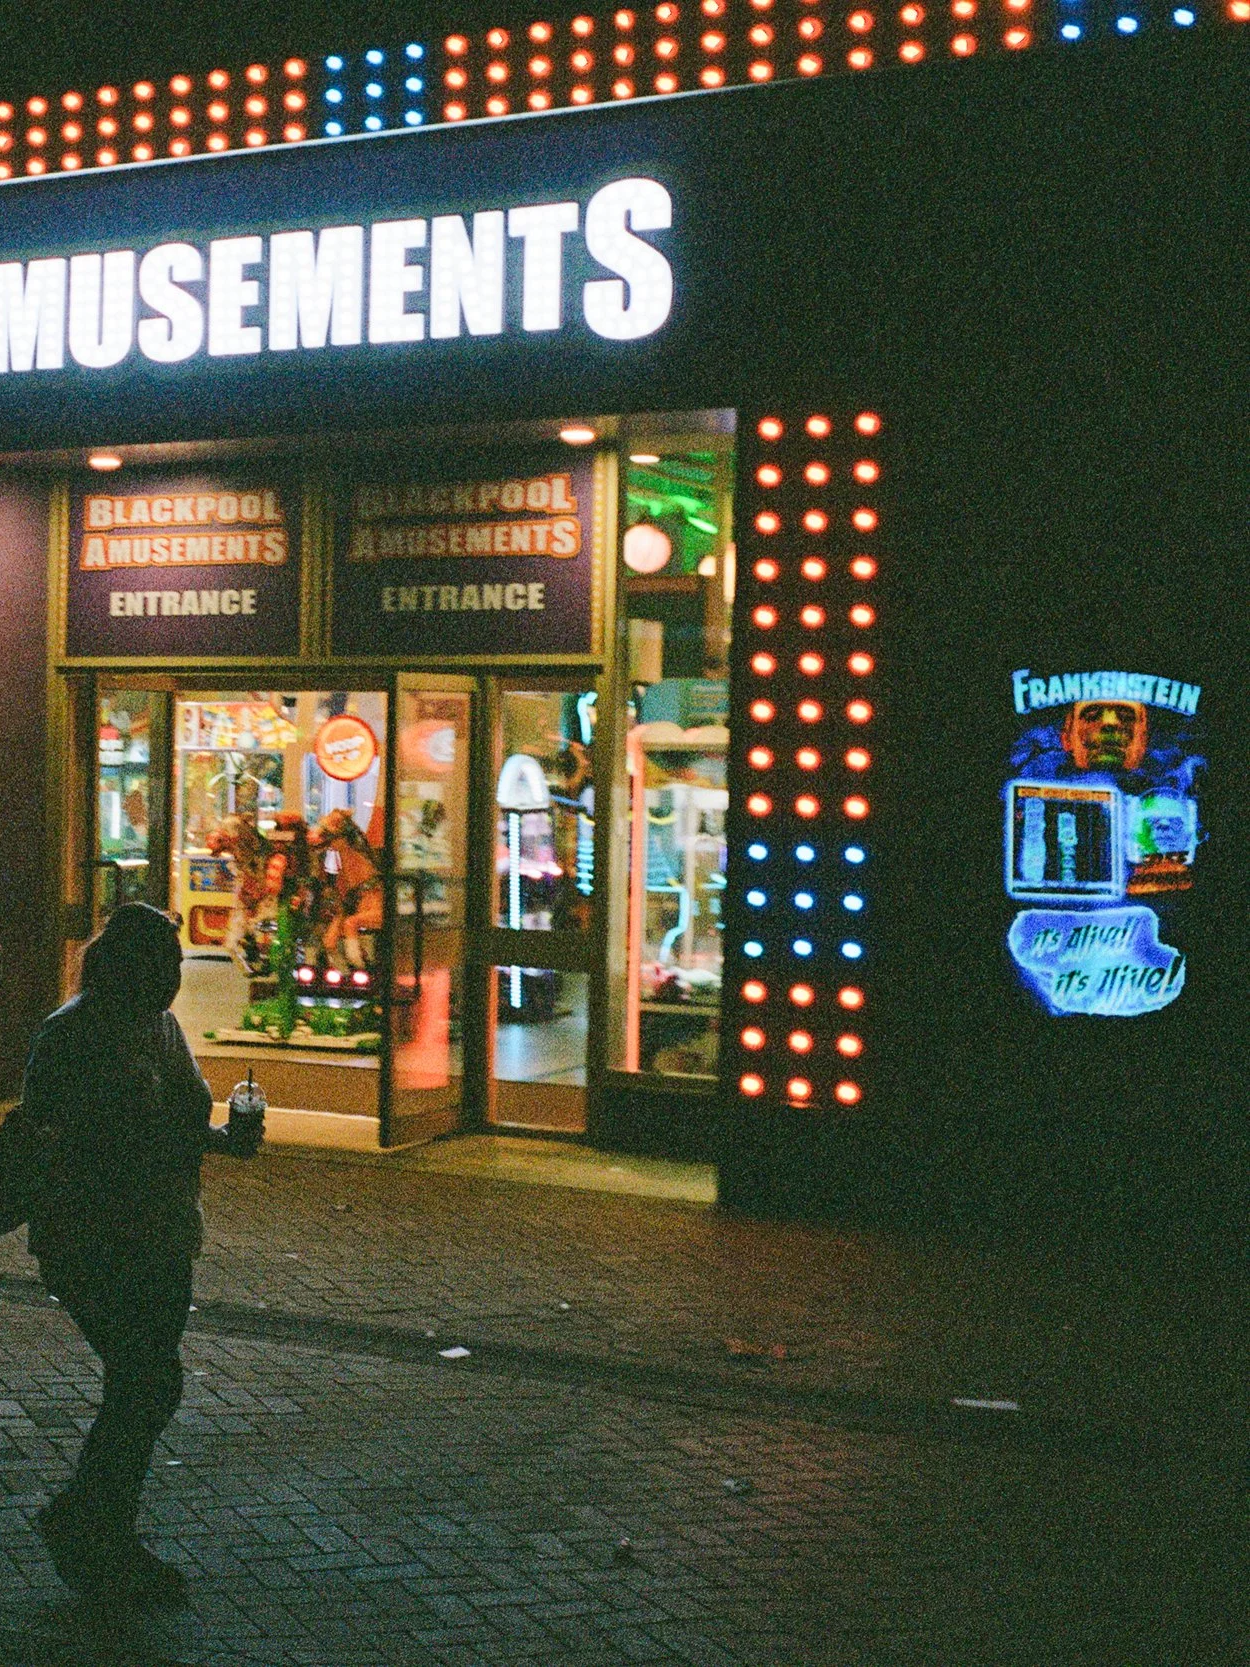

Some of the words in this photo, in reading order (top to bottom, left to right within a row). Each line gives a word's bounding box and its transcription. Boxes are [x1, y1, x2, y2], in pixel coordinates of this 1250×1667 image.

[88, 490, 283, 527] BLACKPOOL
[85, 530, 287, 568] AMUSEMENTS
[351, 519, 577, 558] AMUSEMENTS
[109, 588, 257, 616] ENTRANCE
[381, 582, 546, 612] ENTRANCE
[1012, 668, 1201, 716] FRANKENSTEIN
